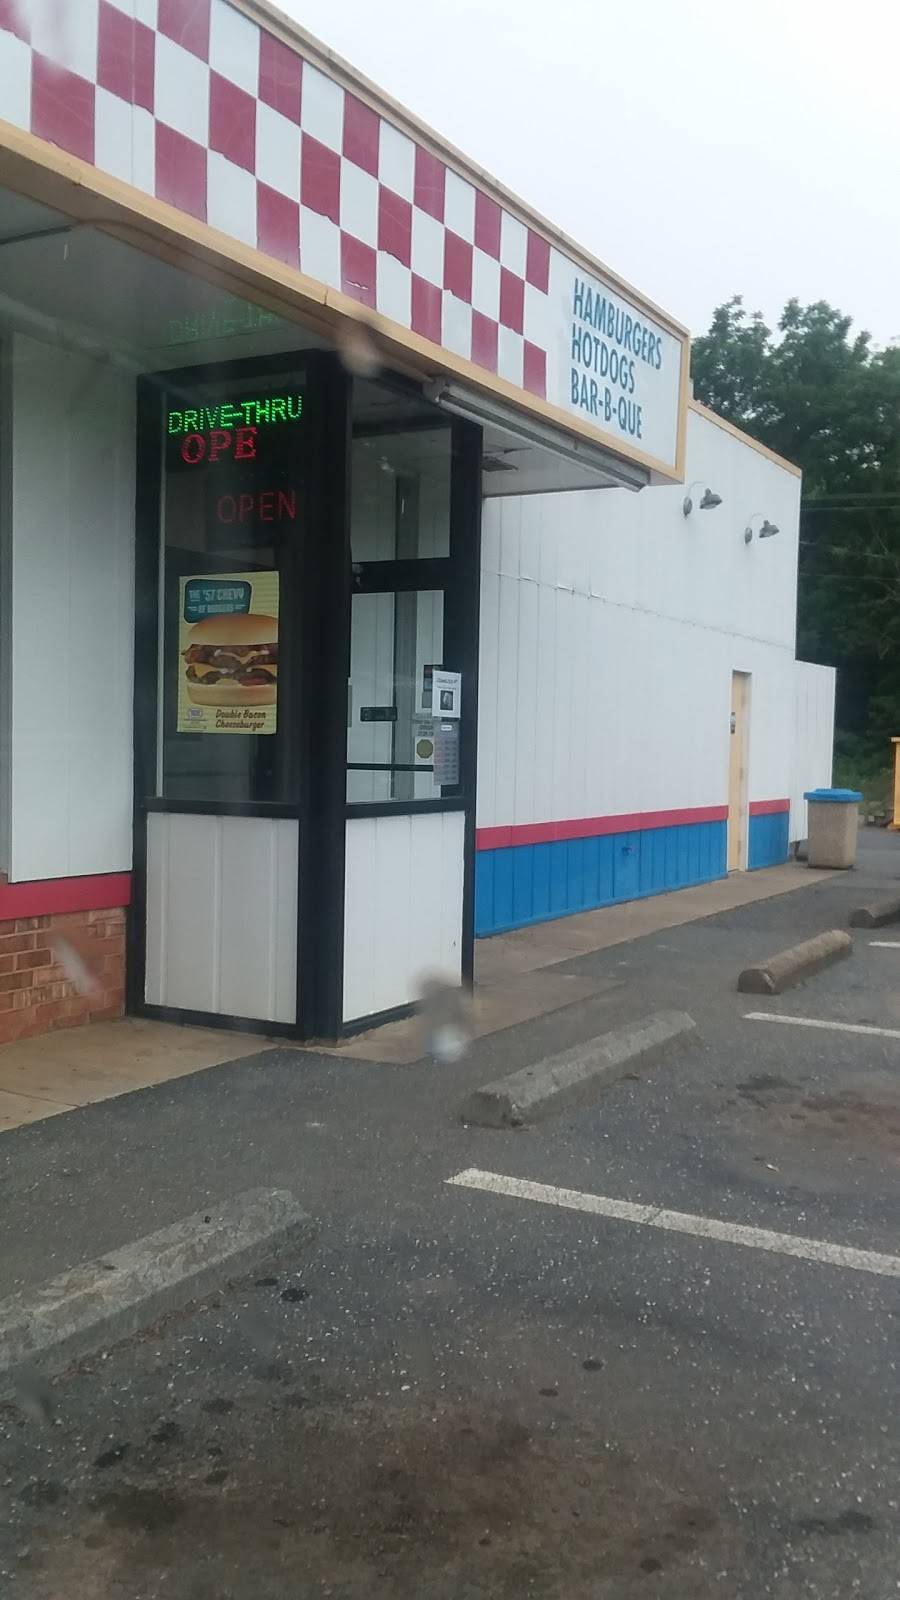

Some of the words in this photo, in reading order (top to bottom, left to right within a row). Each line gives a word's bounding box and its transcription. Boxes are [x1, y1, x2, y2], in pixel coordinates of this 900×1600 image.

[573, 278, 662, 370] HAMBURGERS
[571, 323, 636, 394] HOTDOGS
[168, 396, 303, 433] DRIVE-THRU
[571, 368, 643, 439] BAR-B-QUE
[217, 490, 296, 524] OPEN
[217, 587, 245, 601] CHEVY
[215, 708, 242, 719] Double
[243, 709, 267, 719] Bacon
[215, 719, 265, 731] Cheeseburger
